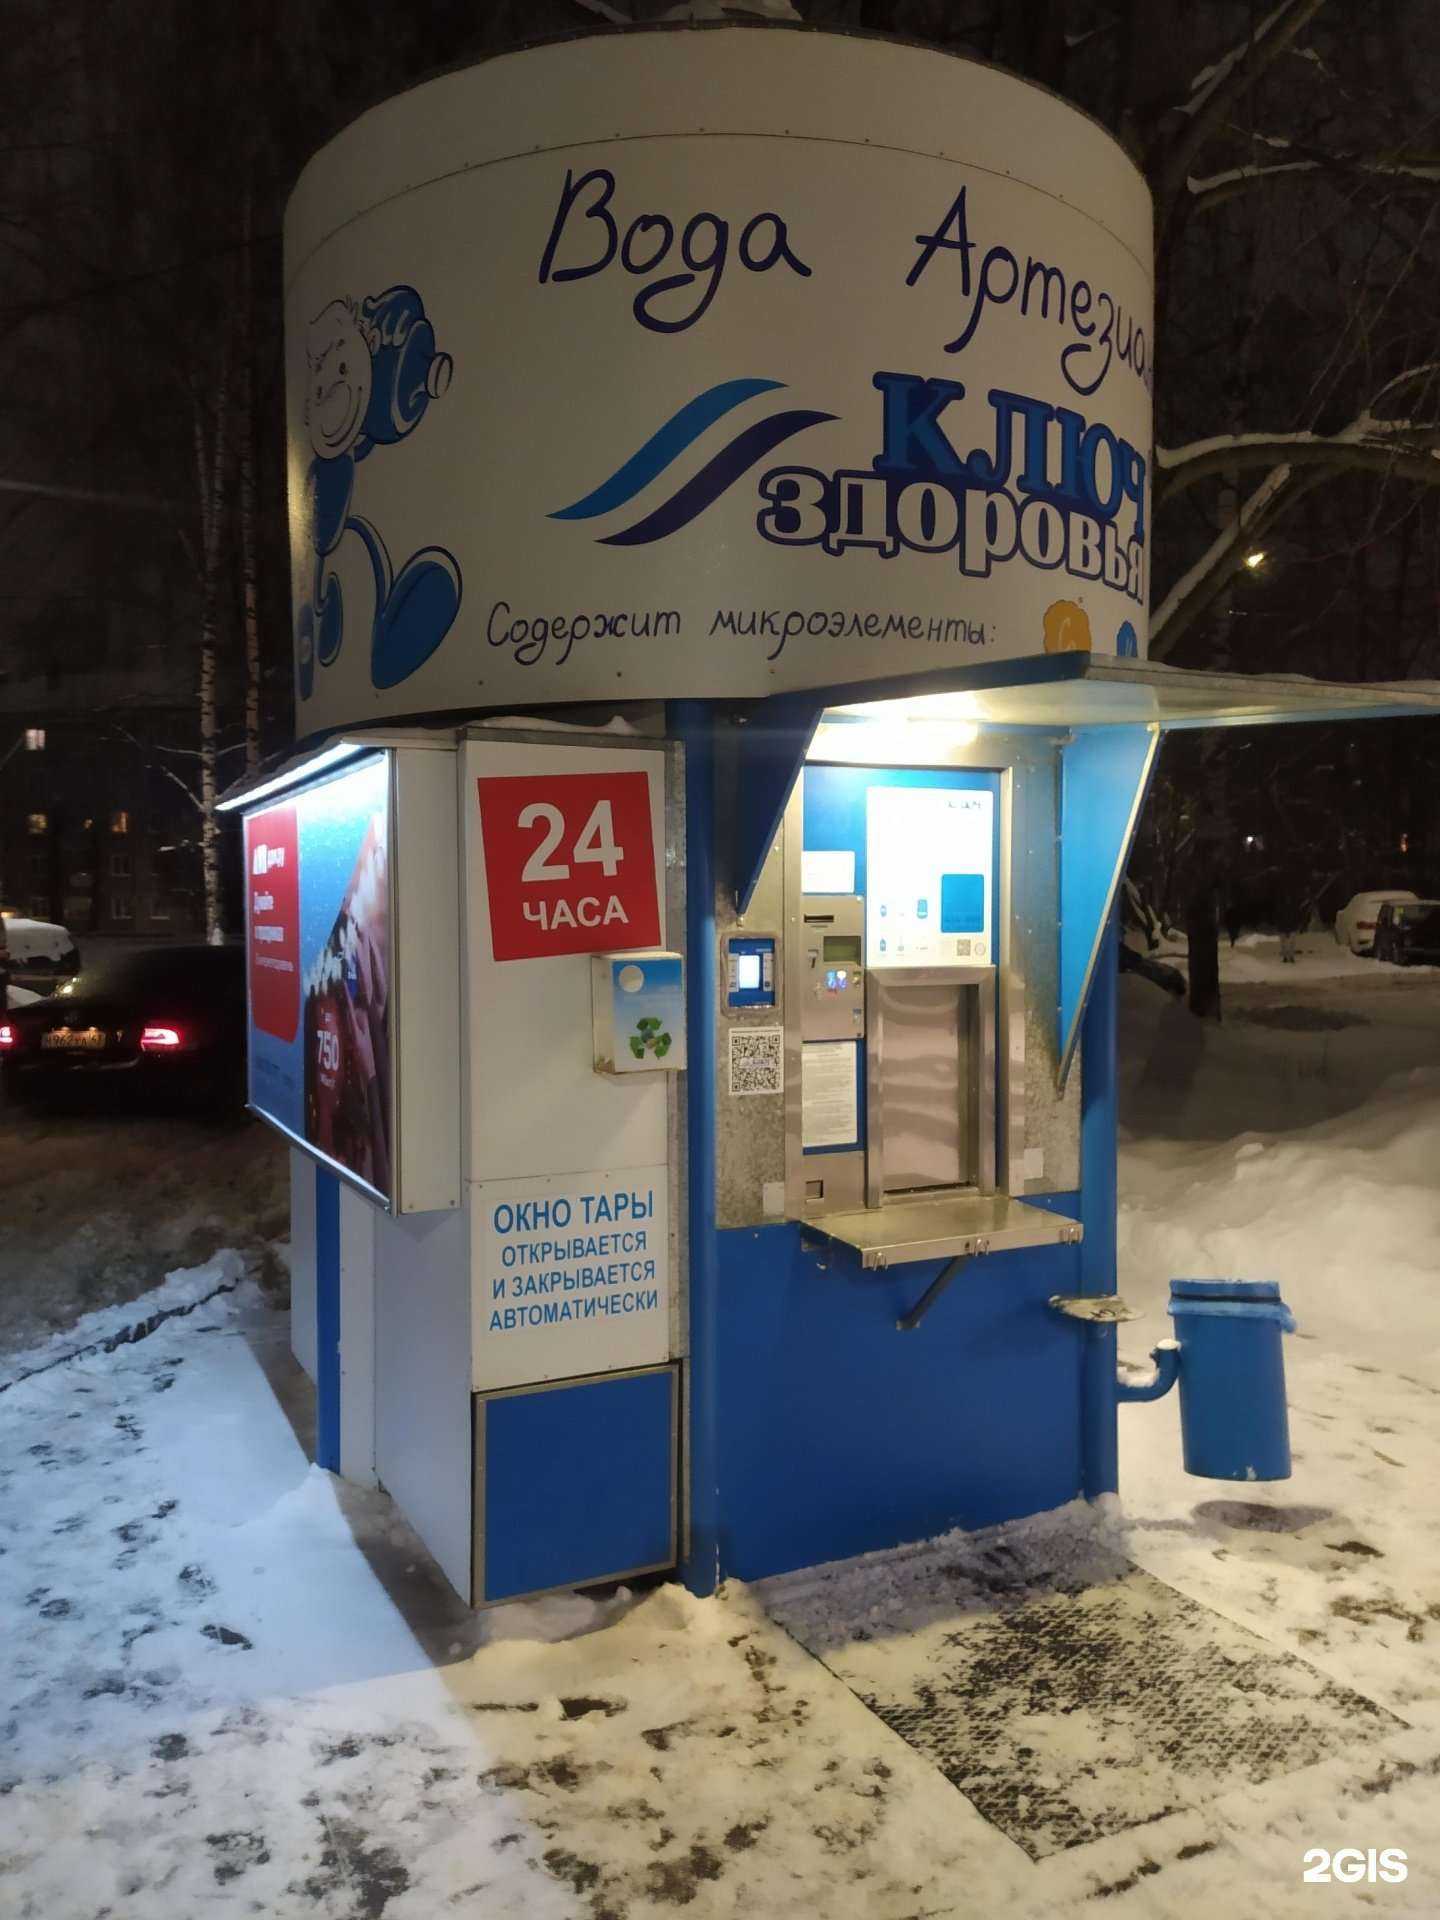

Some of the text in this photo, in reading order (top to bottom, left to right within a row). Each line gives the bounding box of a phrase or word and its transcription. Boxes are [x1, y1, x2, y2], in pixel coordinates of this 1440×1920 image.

[538, 168, 1152, 395] Вода Артезиа
[872, 371, 1146, 538] КЛЮЧ
[487, 601, 681, 666] Содержит
[709, 610, 997, 661] микроэлементы:
[518, 800, 624, 882] 24
[522, 895, 629, 930] ЧАСА
[494, 1190, 653, 1233] ОКНО ТАРЫ
[502, 1231, 647, 1267] ОТКРЫВАЕТСЯ
[492, 1260, 655, 1300] И ЗАКРЫВАЕТСЯ
[489, 1290, 658, 1331] АВТОМАТИЧЕСКИ
